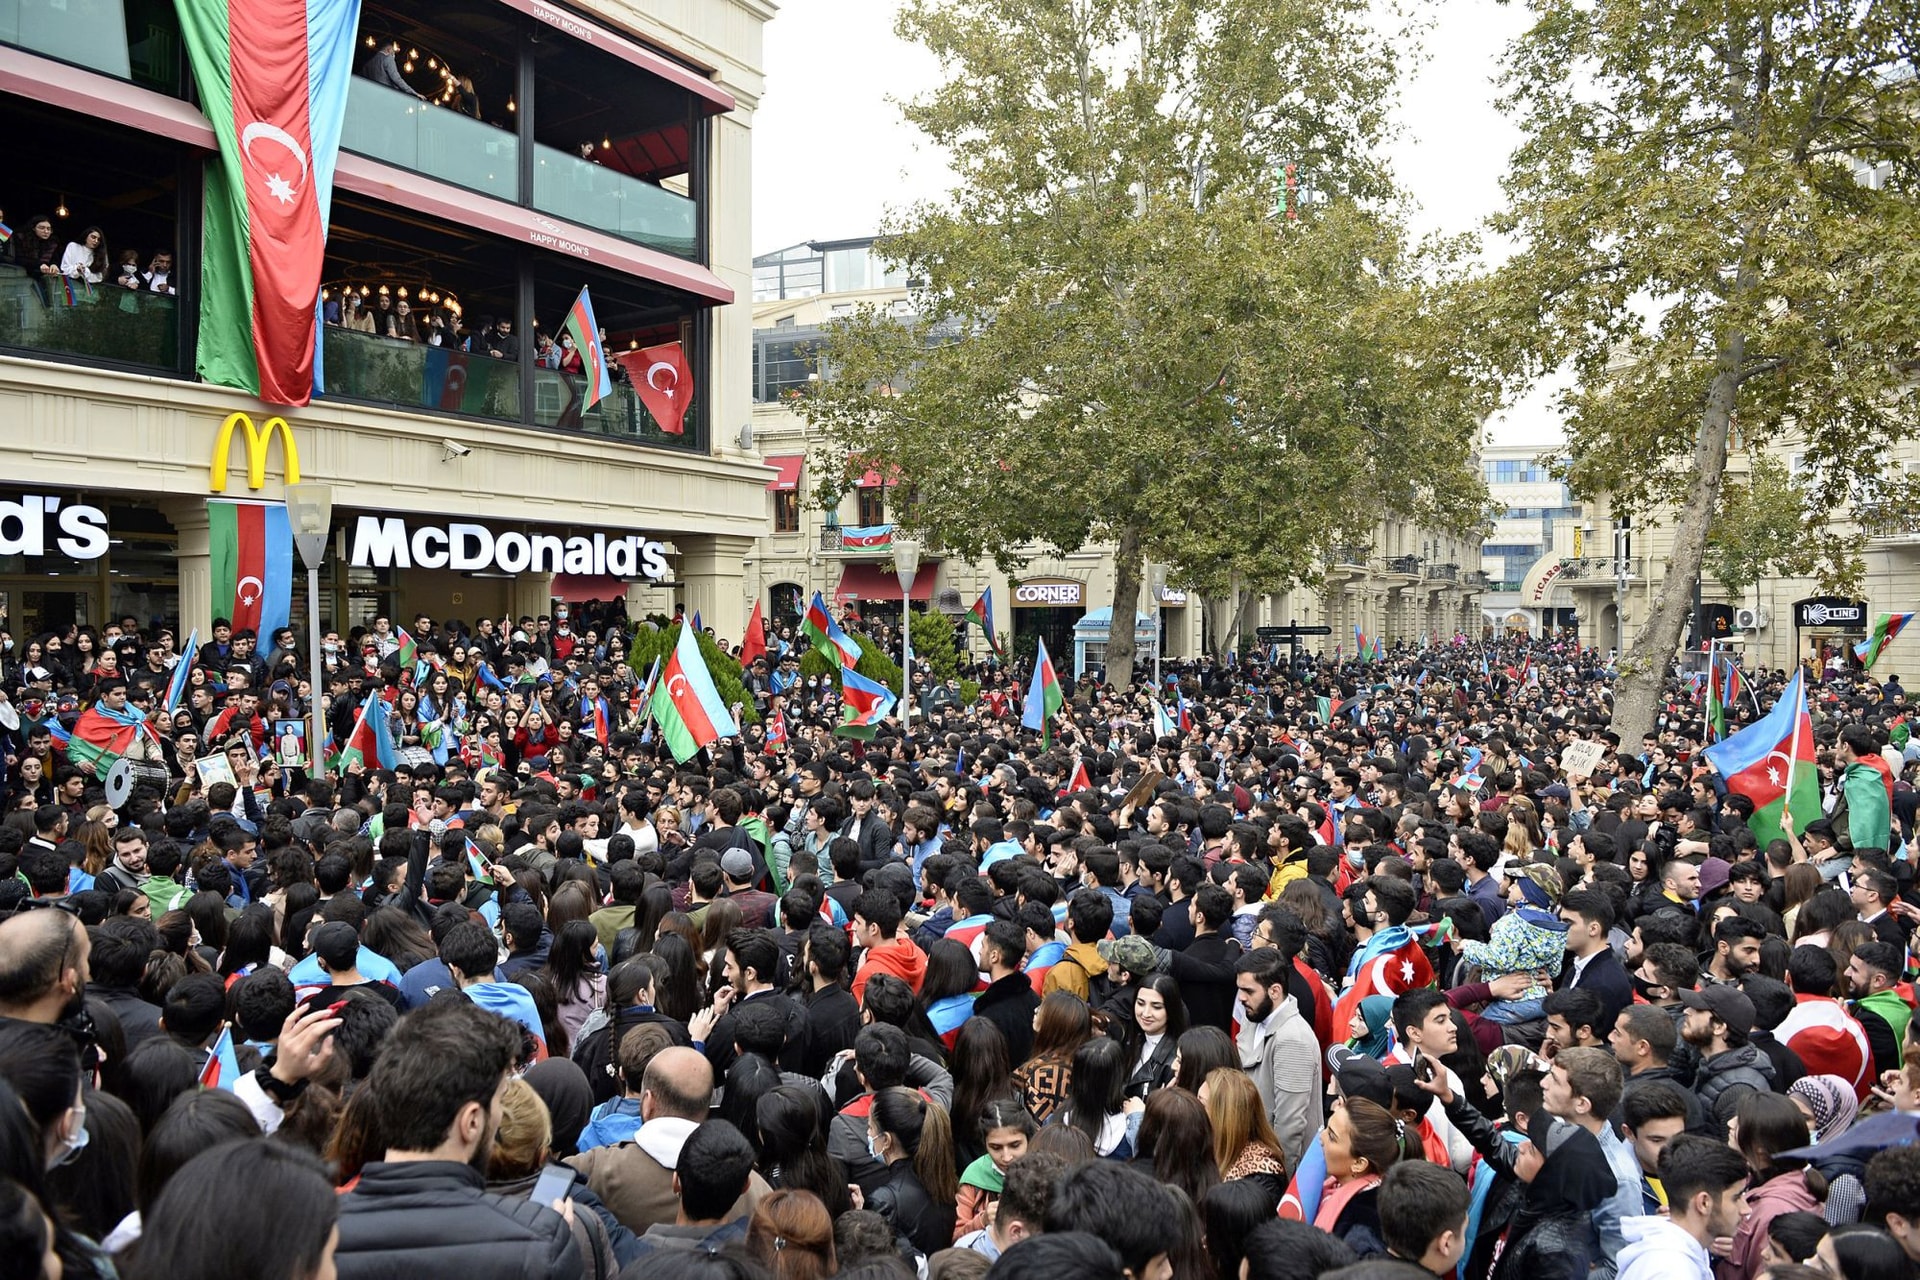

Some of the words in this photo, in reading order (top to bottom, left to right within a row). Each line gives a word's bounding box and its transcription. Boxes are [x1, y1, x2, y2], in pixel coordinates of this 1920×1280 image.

[533, 6, 560, 25] HAPPY
[561, 19, 592, 40] MOON'S
[530, 231, 558, 247] HAPPY
[558, 240, 590, 257] MOON'S
[0, 494, 110, 560] d's
[351, 515, 668, 578] McDonald's
[1016, 586, 1077, 602] CORNER
[1833, 609, 1855, 618] LINE
